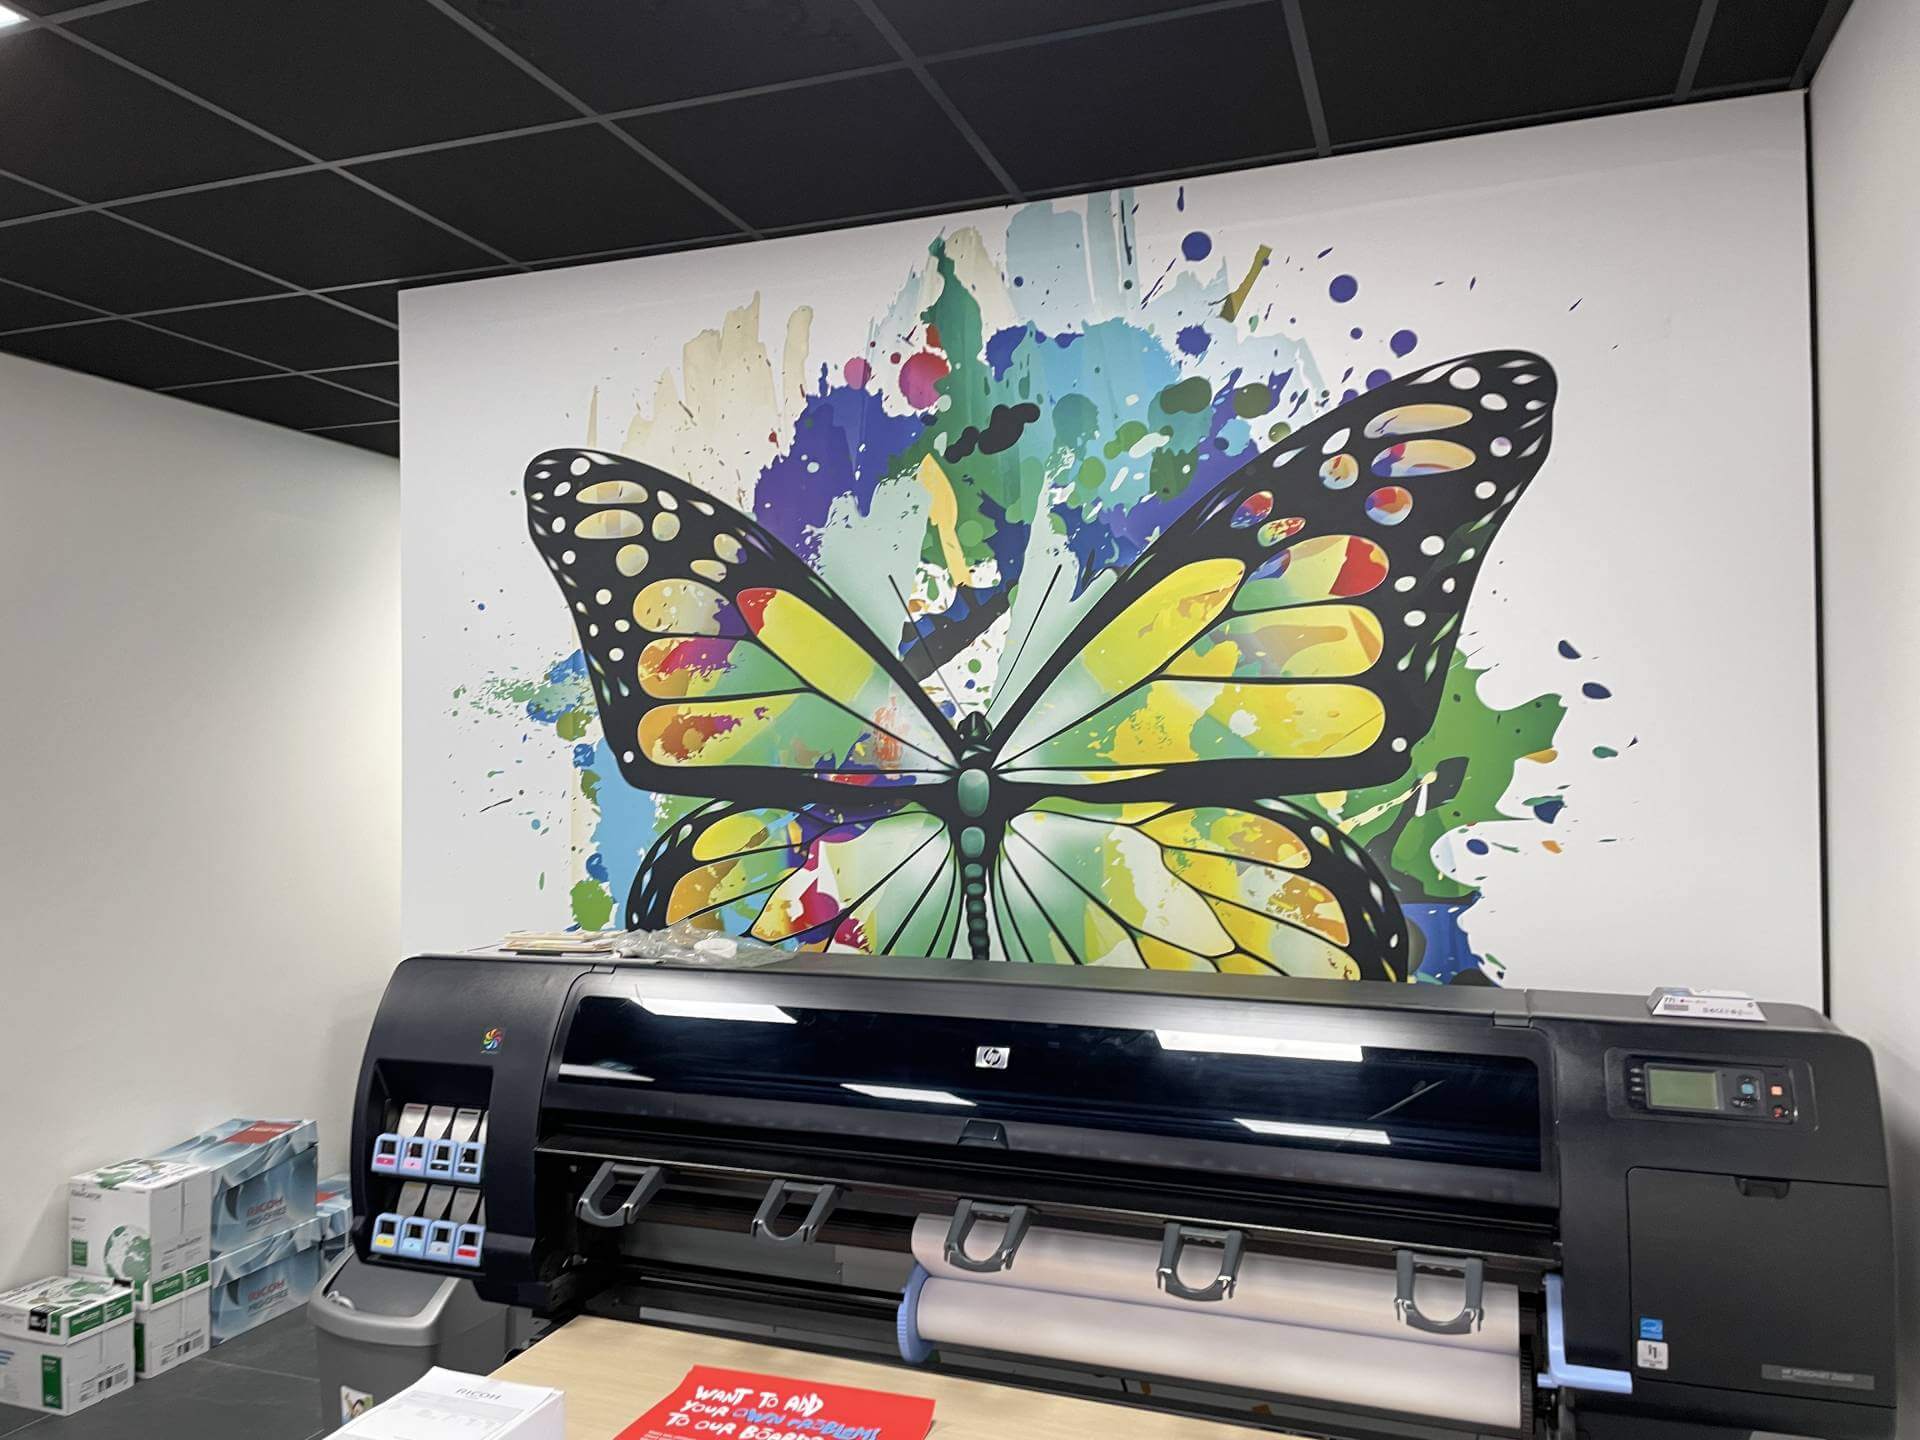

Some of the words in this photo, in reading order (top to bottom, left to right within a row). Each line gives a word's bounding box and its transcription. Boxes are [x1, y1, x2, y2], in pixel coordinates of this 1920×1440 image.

[455, 1387, 502, 1400] RICOH
[694, 1385, 754, 1406] WANT
[758, 1391, 780, 1409] TO
[784, 1392, 824, 1417] ADD
[666, 1411, 690, 1427] TO
[694, 1420, 737, 1436] OUR
[680, 1399, 730, 1417] YOUR
[732, 1407, 787, 1425] OWN
